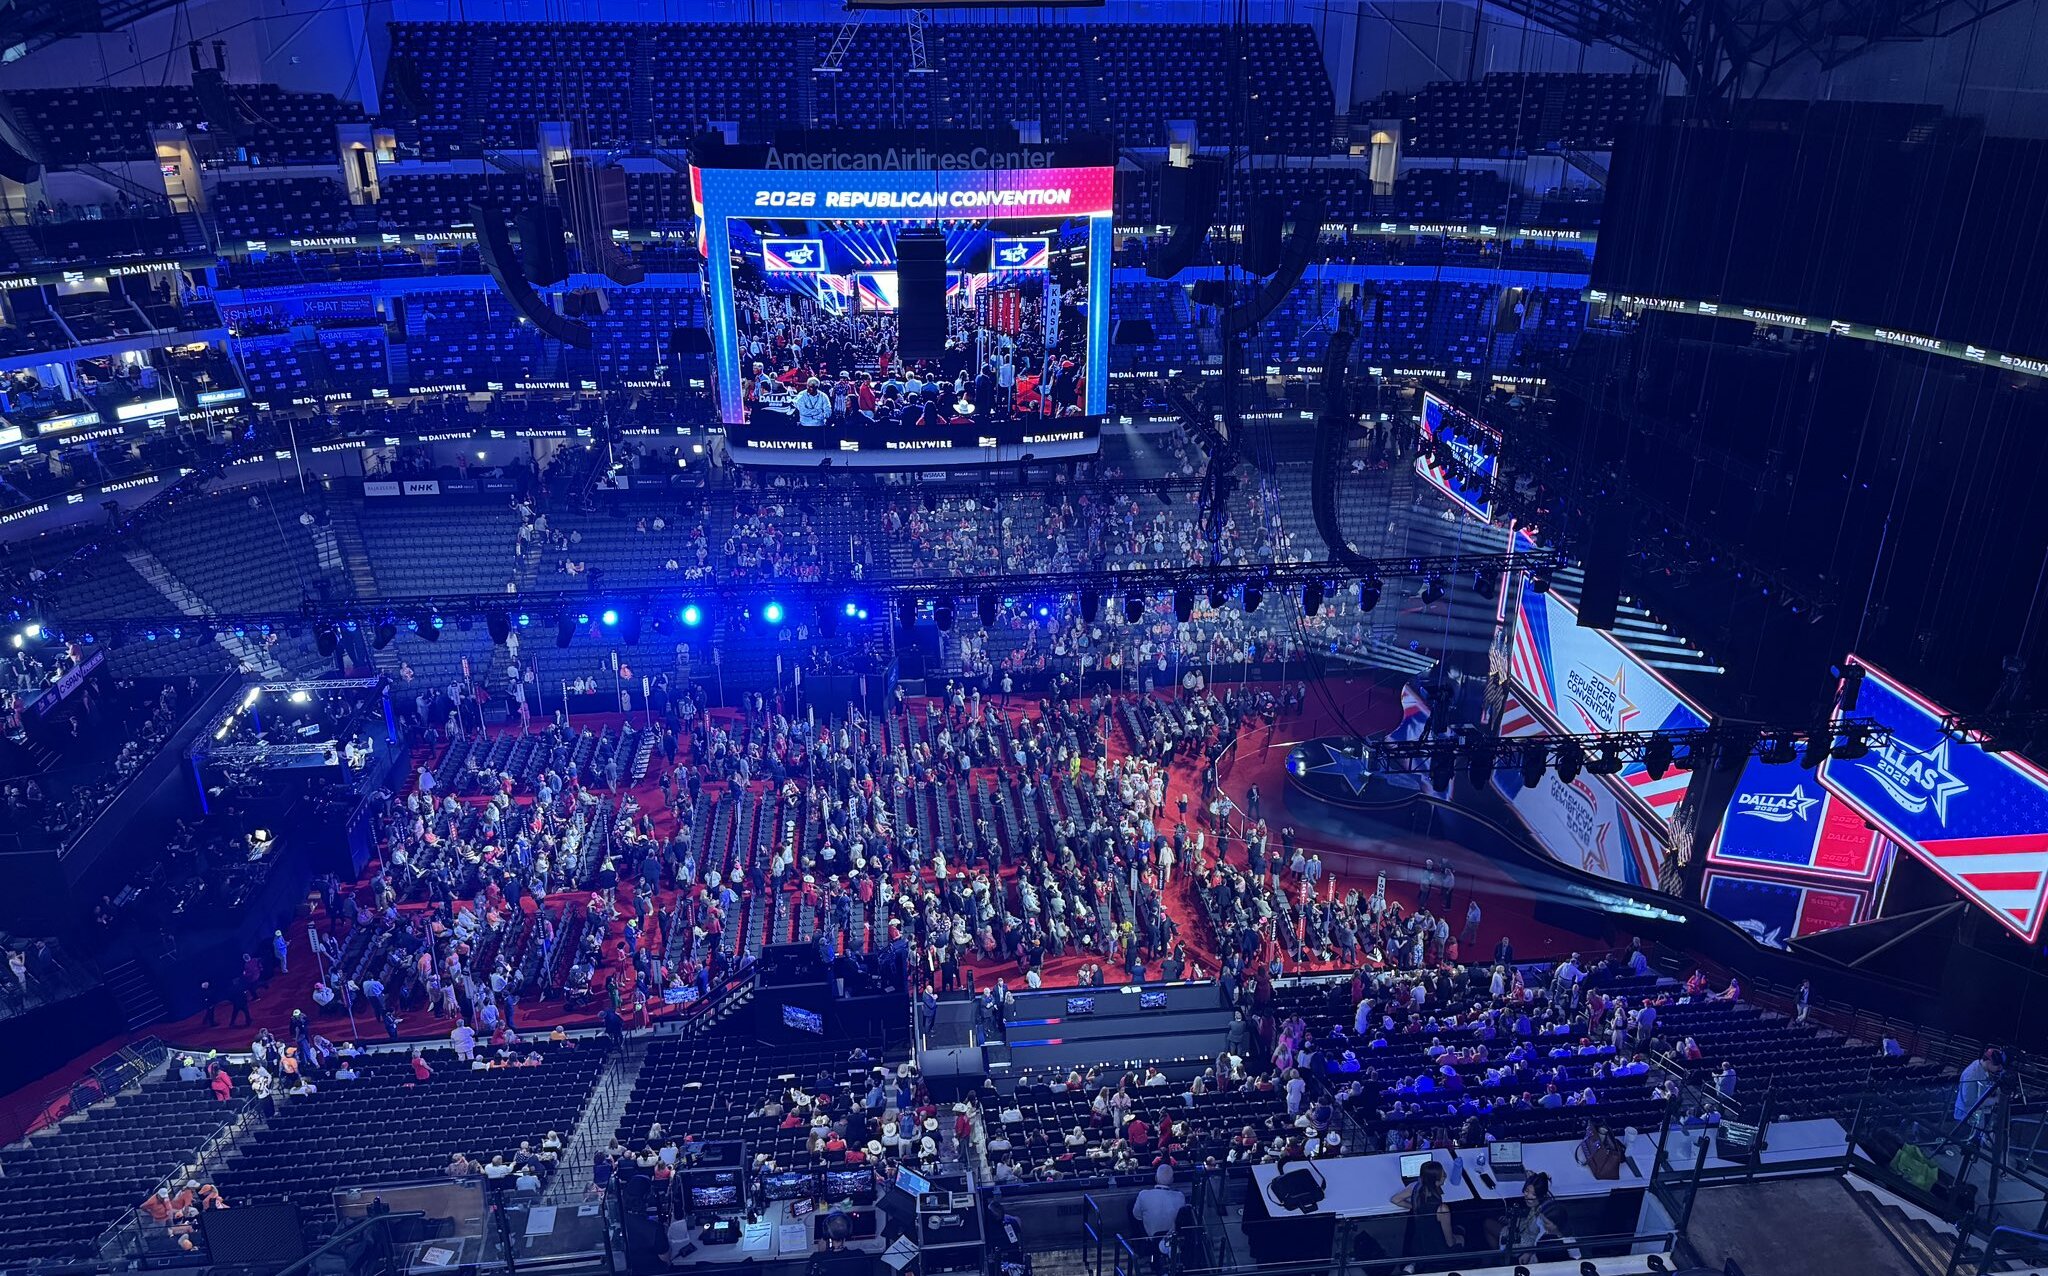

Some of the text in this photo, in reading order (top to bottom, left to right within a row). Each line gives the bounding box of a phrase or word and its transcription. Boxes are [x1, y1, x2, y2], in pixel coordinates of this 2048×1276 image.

[765, 147, 1055, 170] AmericanAirlinesCenter
[754, 188, 1071, 208] 2026 REPUBLICAN CONVENTION
[1420, 224, 1468, 234] DAILYWIRE
[1531, 229, 1581, 239] DAILYWIRE
[303, 236, 357, 247] DAILYWIRE
[426, 232, 477, 241] DAILYWIRE
[123, 262, 180, 275] DAILYWIRE
[304, 301, 338, 313] X-BAT
[1049, 288, 1058, 345] KANSAS
[1754, 310, 1807, 326] DAILYWIRE
[1887, 331, 1941, 350] DAILYWIRE
[1403, 368, 1446, 378] DAILYWIRE
[420, 383, 467, 394] DAILYWIRE
[525, 381, 570, 389] DAILYWIRE
[190, 406, 240, 421] DAILYWIRE
[71, 426, 124, 443] DAILYWIRE
[429, 432, 471, 442] DAILYWIRE
[1034, 431, 1084, 443] DAILYWIRE
[322, 440, 366, 452] DAILYWIRE
[760, 440, 813, 450] DAILYWIRE
[899, 440, 953, 450] DAILYWIRE
[112, 475, 159, 491] DAILYWIRE
[410, 484, 433, 492] NHK
[2, 503, 49, 524] DAILYWIRE
[59, 669, 82, 694] C-SPAN
[1569, 670, 1615, 714] REPUBLICAN
[1590, 676, 1616, 703] 2026
[1567, 679, 1613, 725] CONVENTION
[1877, 759, 1910, 787] 2026
[1738, 793, 1799, 809] DALLAS
[1754, 805, 1779, 813] 2026
[1827, 833, 1867, 844] DALLAS
